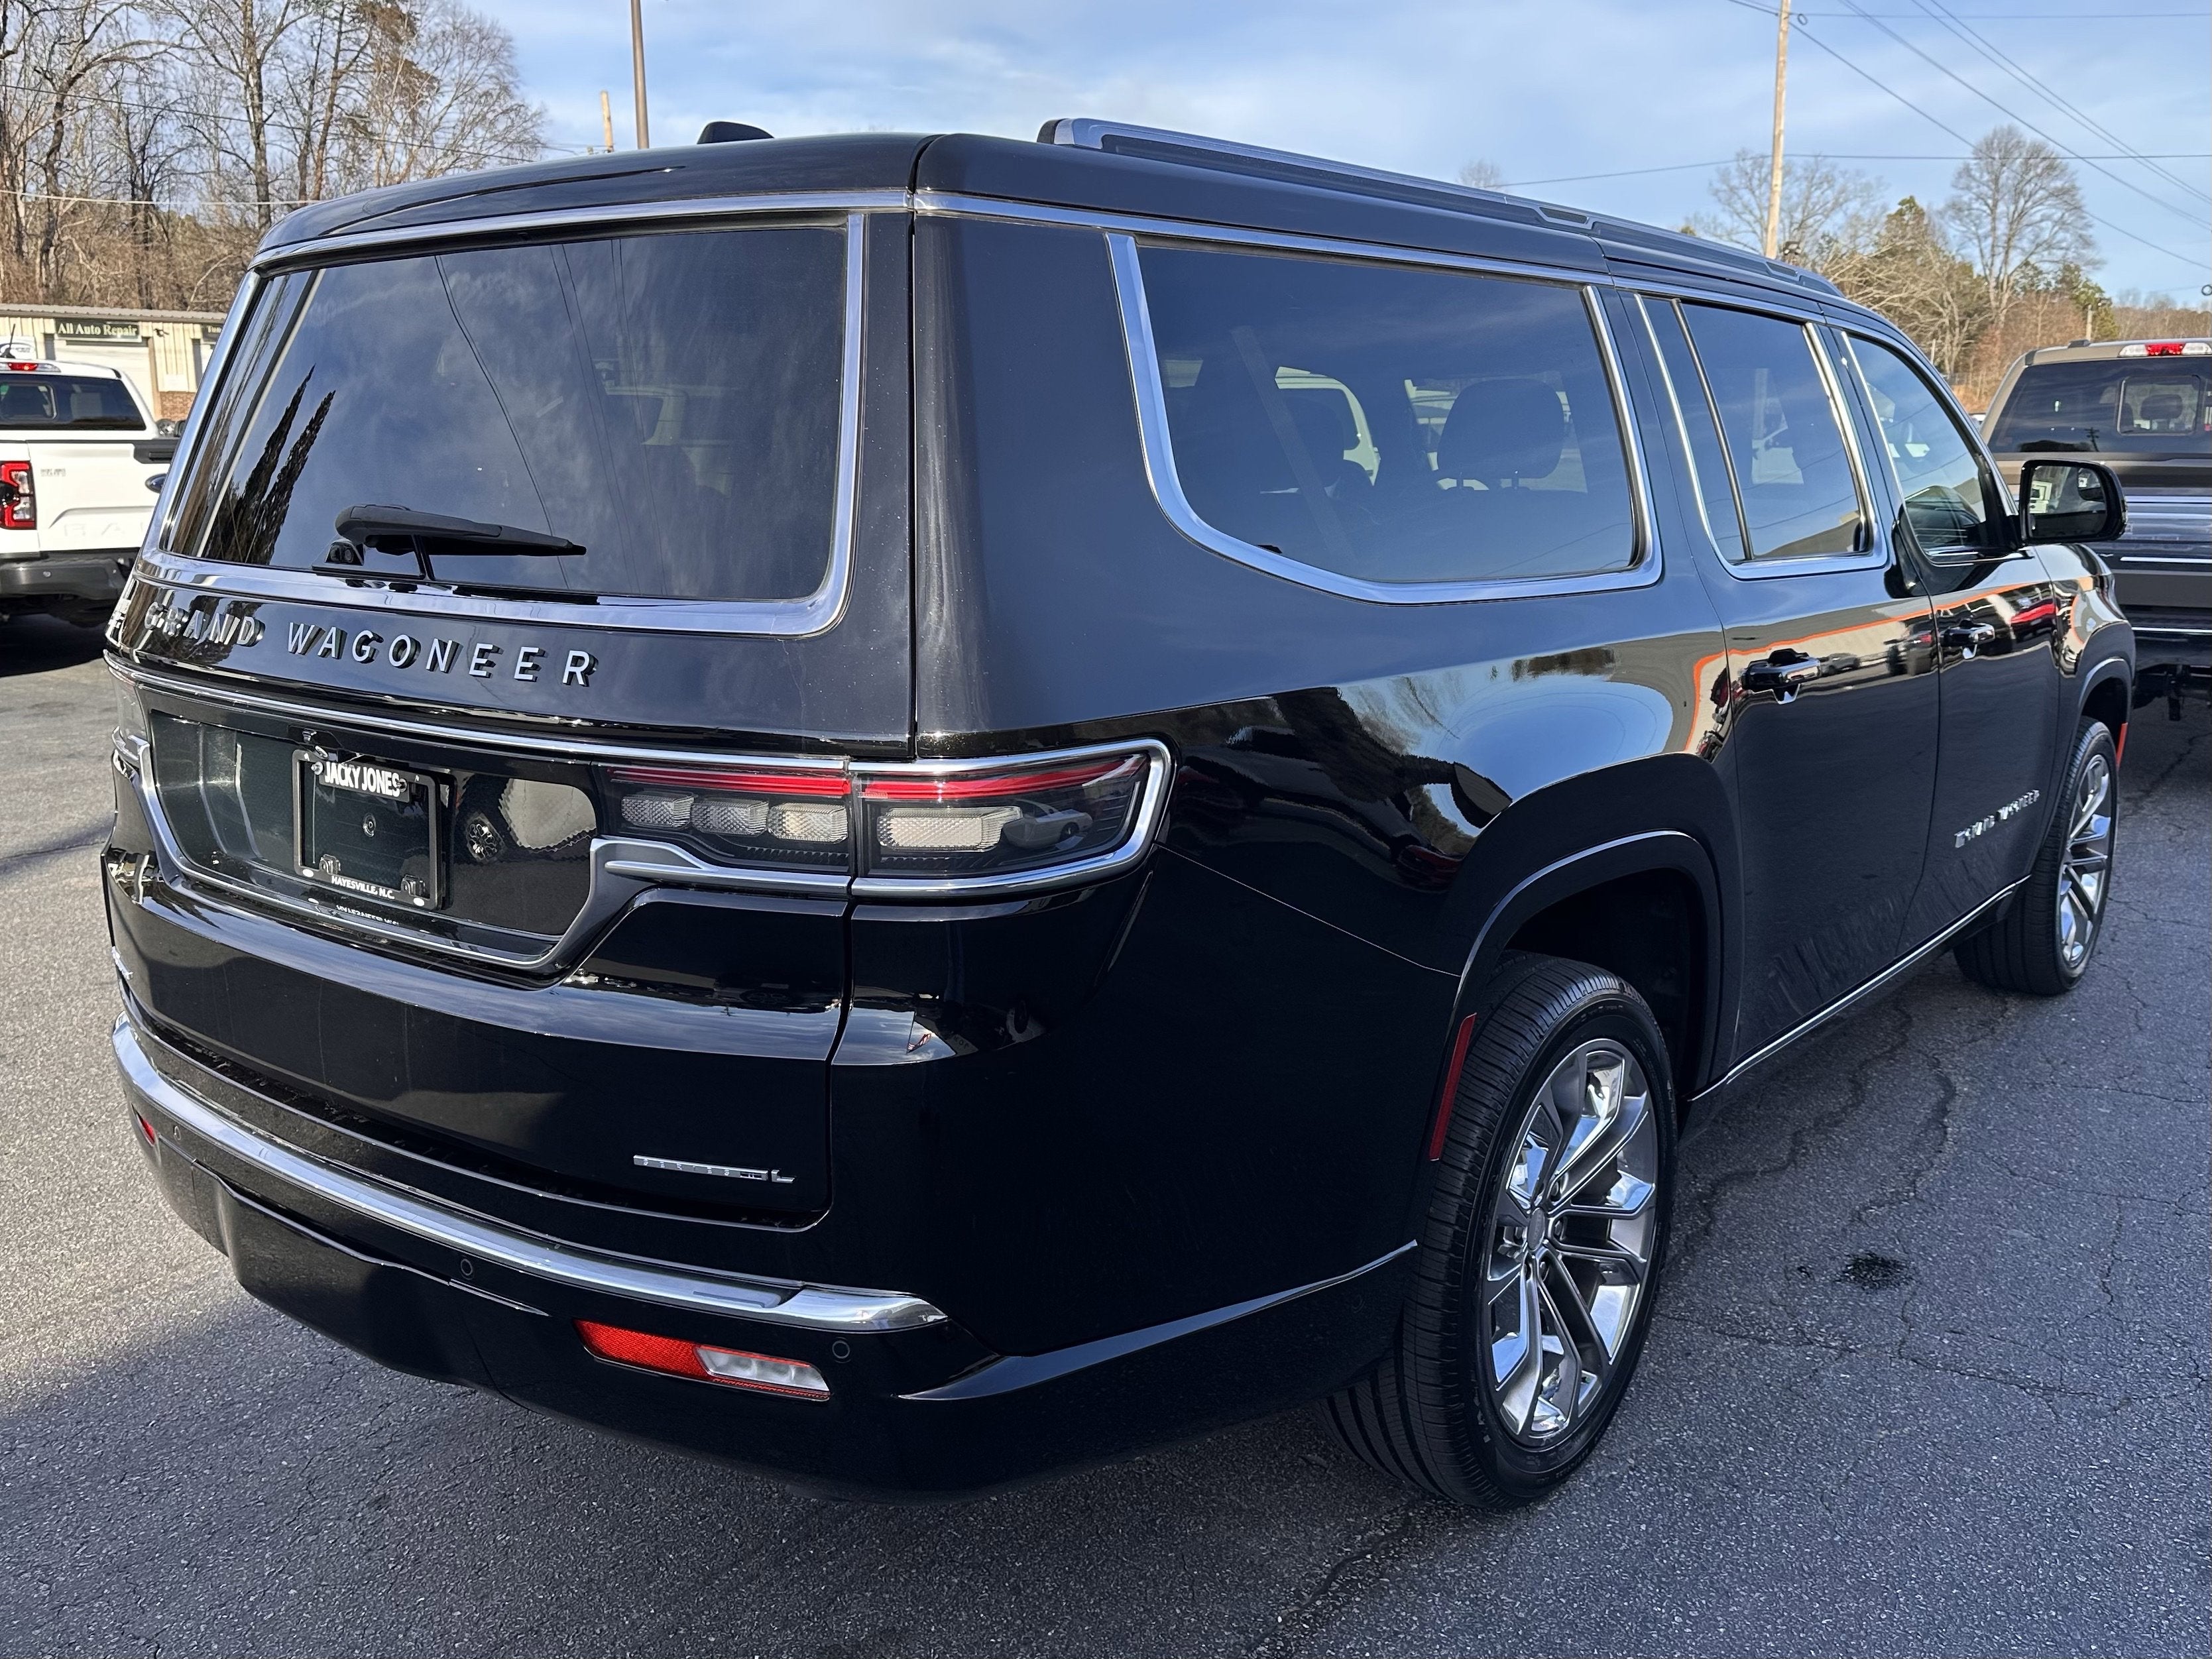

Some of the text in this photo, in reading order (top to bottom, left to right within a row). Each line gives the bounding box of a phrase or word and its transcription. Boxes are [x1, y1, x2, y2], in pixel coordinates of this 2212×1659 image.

[58, 323, 137, 337] All Auto Repair
[144, 601, 597, 687] GRAND WAGONEER
[324, 762, 400, 797] JACKY JONES
